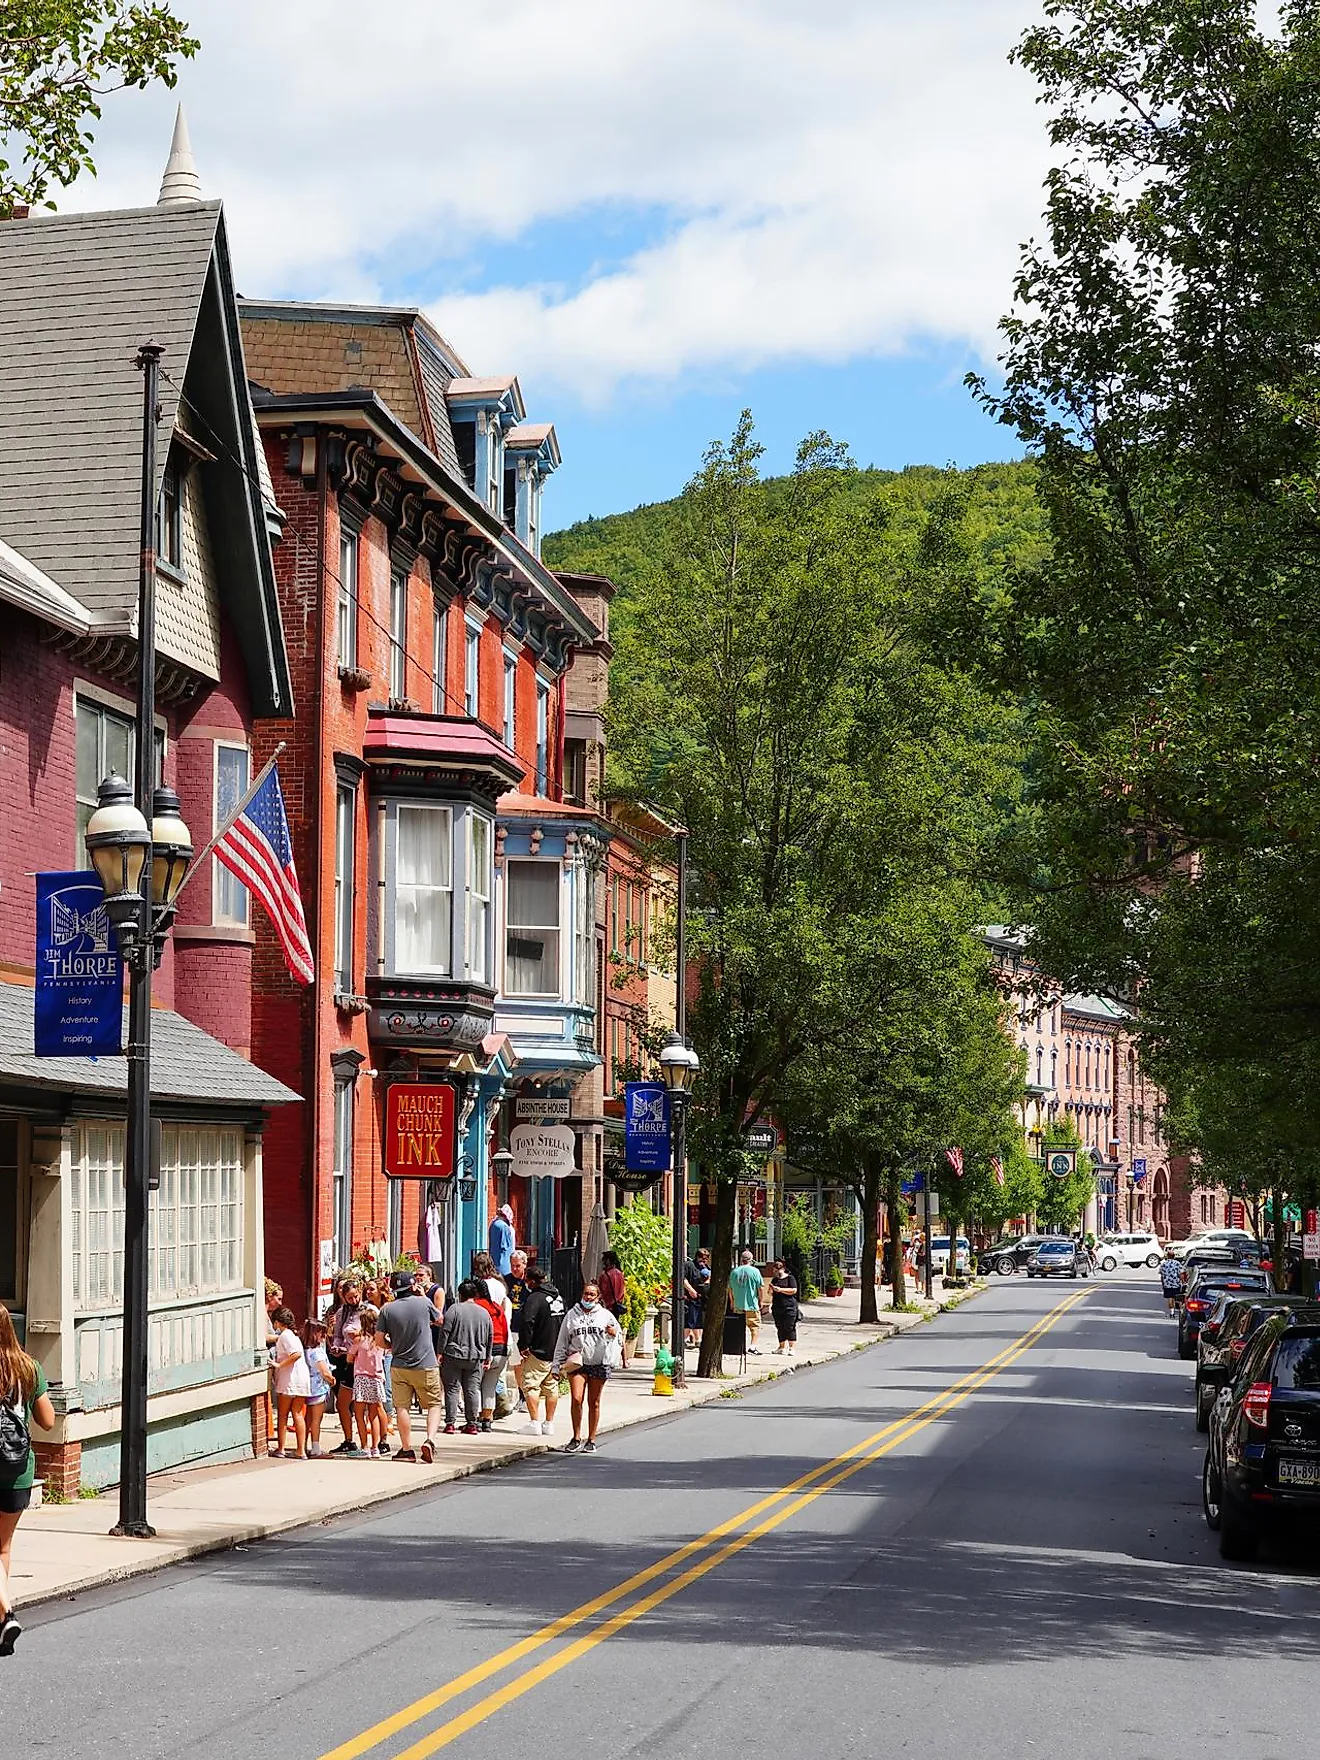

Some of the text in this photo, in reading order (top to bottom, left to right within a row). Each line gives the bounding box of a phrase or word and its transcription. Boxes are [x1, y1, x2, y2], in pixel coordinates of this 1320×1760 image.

[43, 949, 61, 960] JIM
[48, 951, 117, 980] THORPE
[68, 997, 92, 1005] History
[63, 1035, 92, 1044] Inspiring
[397, 1095, 443, 1113] MAUCH
[517, 1103, 568, 1113] ABSINTHE HOUSE
[397, 1114, 443, 1131] CHUNK
[633, 1120, 666, 1133] THORPE
[397, 1133, 443, 1165] INK
[516, 1137, 535, 1150] TONY
[616, 1169, 647, 1179] House
